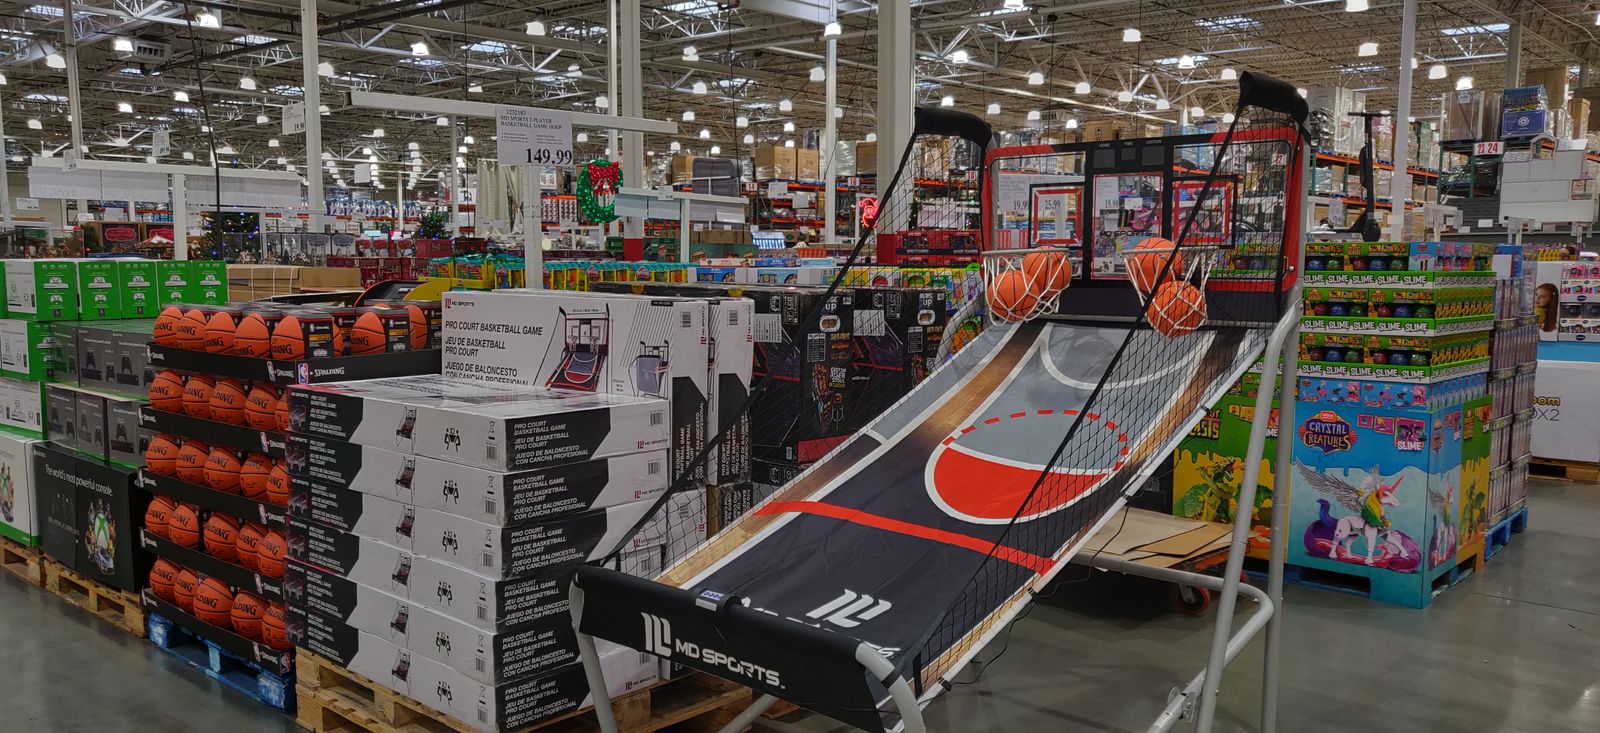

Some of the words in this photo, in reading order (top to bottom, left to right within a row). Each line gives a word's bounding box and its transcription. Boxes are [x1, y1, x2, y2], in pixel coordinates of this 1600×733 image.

[1488, 142, 1498, 154] 24
[526, 148, 572, 165] 149.99
[1304, 274, 1324, 284] SLIME
[1328, 274, 1348, 284] SLIME
[1352, 275, 1374, 284] SLIME
[1378, 275, 1400, 284] SLIME
[1404, 276, 1427, 285] SLIME
[445, 321, 457, 329] PRO
[459, 322, 479, 331] COURT
[480, 323, 521, 334] BASKETBALL
[523, 326, 543, 336] GAME
[1304, 320, 1325, 329] SLIME
[1328, 320, 1350, 329] SLIME
[1353, 321, 1375, 330] SLIME
[1379, 322, 1400, 332] SLIME
[1405, 322, 1428, 333] SLIME
[467, 338, 506, 349] BASKETBALL
[445, 346, 457, 354] PRO
[458, 348, 478, 357] COURT
[277, 369, 294, 378] SPALDING
[314, 367, 344, 377] SPALDING
[445, 362, 464, 370] JUEGO
[475, 365, 517, 377] BALONCESTO
[1302, 365, 1322, 374] SLIME
[1326, 366, 1347, 375] SLIME
[1350, 367, 1372, 376] SLIME
[1376, 368, 1398, 378] SLIME
[1402, 370, 1425, 380] SLIME
[514, 427, 549, 435] BASKETBALL
[1189, 419, 1219, 438] ASTS
[1310, 421, 1346, 434] CRYSTAL
[536, 432, 570, 441] BASKETBALL
[1304, 432, 1351, 451] CREATURES
[544, 445, 579, 455] BALONCESTO
[1397, 441, 1421, 450] SLIME
[553, 450, 588, 459] PROFESIONAL
[66, 474, 75, 483] most
[76, 478, 95, 490] powerful
[513, 482, 548, 491] BASKETBALL
[534, 486, 568, 496] BASKETBALL
[543, 498, 577, 509] BALONCESTO
[528, 509, 550, 518] CANCHA
[551, 502, 586, 513] PROFESIONAL
[524, 527, 544, 535] COURT
[511, 533, 546, 544] BASKETBALL
[533, 537, 566, 548] BASKETBALL
[525, 547, 544, 555] COURT
[541, 548, 576, 560] BALONCESTO
[526, 561, 549, 569] CANCHA
[550, 552, 584, 564] PROFESIONAL
[503, 637, 537, 650] BASKETBALL
[538, 631, 554, 639] GAME
[516, 631, 535, 640] COURT
[524, 638, 557, 652] BASKETBALL
[503, 663, 522, 672] JUEGO
[532, 649, 566, 664] BALONCESTO
[516, 650, 535, 660] COURT
[517, 664, 539, 673] CANCHA
[540, 652, 574, 666] PROFESIONAL
[676, 638, 700, 658] MD
[702, 649, 780, 686] SPORTS
